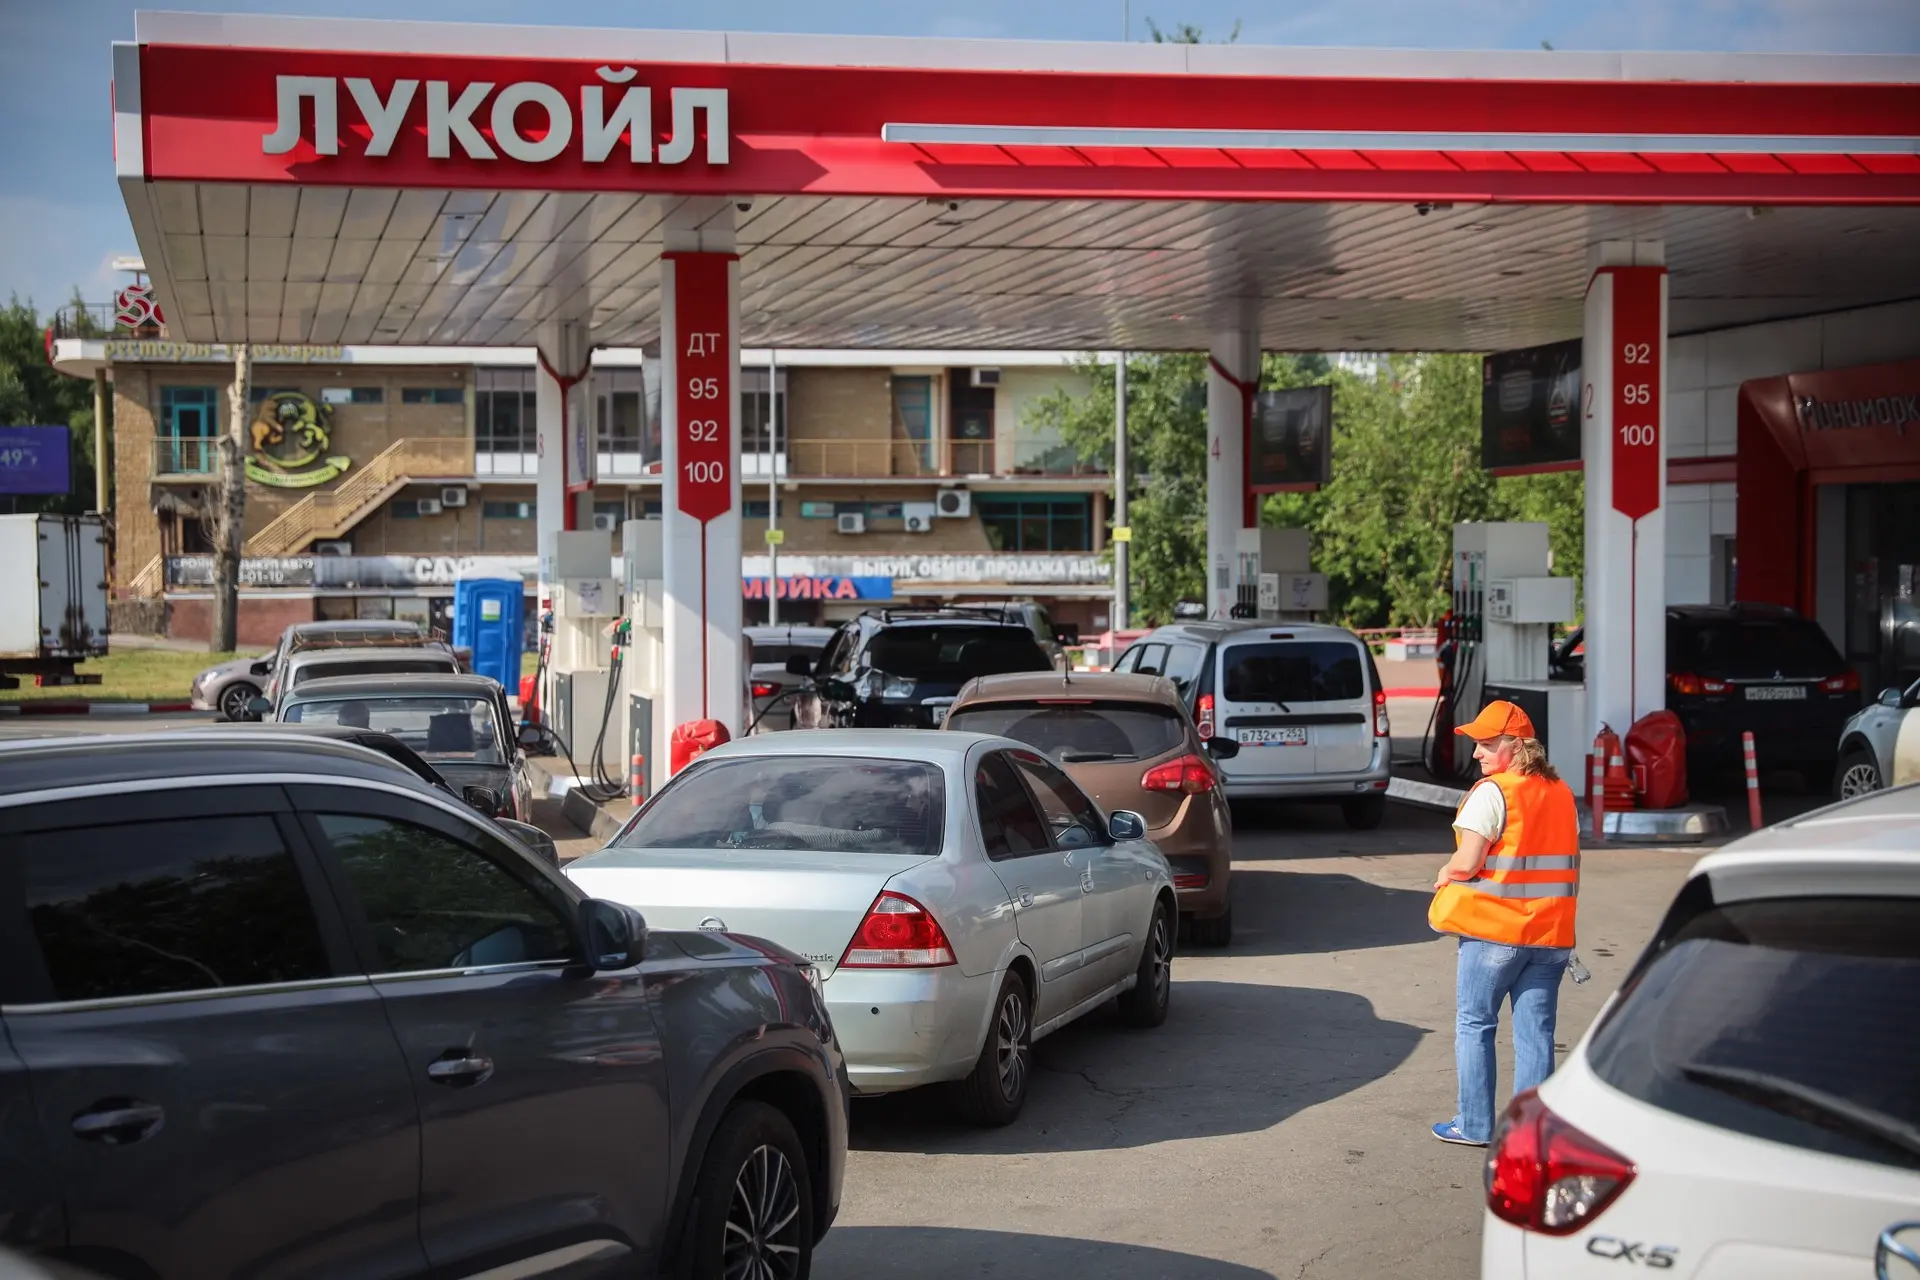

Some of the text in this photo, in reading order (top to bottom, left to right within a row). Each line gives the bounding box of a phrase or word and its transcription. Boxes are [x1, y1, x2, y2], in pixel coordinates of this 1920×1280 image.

[262, 65, 729, 164] ЛУКОЙЛ
[687, 333, 721, 357] ДТ
[1624, 343, 1650, 364] 92
[689, 378, 719, 399] 95
[1624, 384, 1650, 404] 95
[1584, 383, 1593, 419] 2
[689, 420, 718, 441] 92
[1620, 425, 1655, 446] 100
[1211, 435, 1221, 461] 4
[685, 461, 723, 483] 100
[984, 560, 1066, 577] ПРОДАЖА
[1586, 1235, 1679, 1269] CX-5
